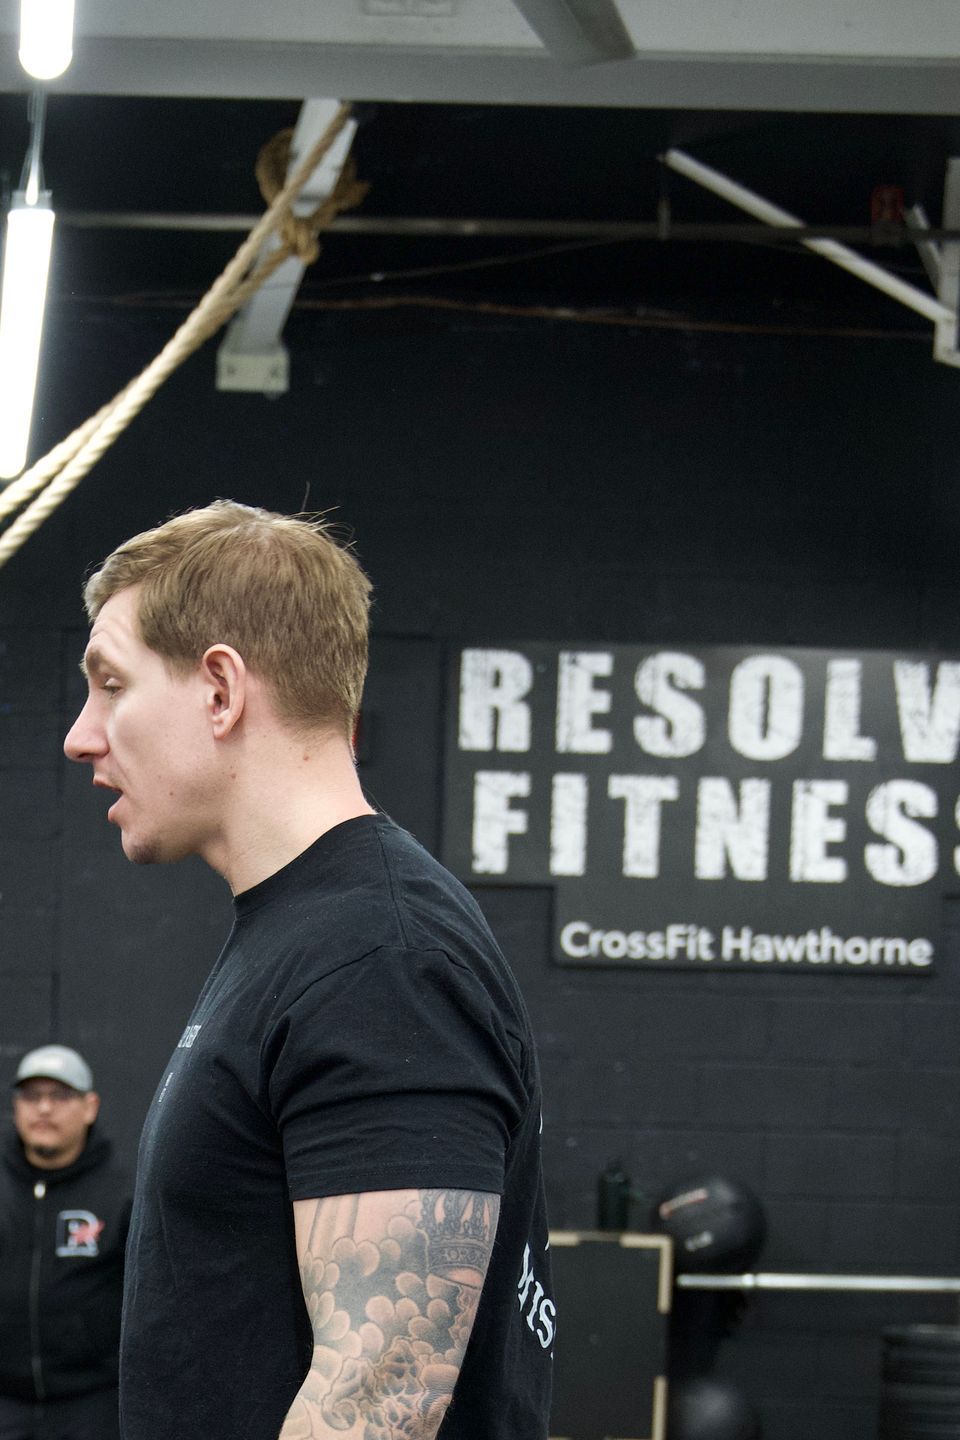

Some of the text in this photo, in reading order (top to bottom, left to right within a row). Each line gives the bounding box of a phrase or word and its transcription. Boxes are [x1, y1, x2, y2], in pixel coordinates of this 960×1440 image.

[472, 771, 960, 886] FITNES
[561, 921, 933, 967] CrossFit Hawthorne
